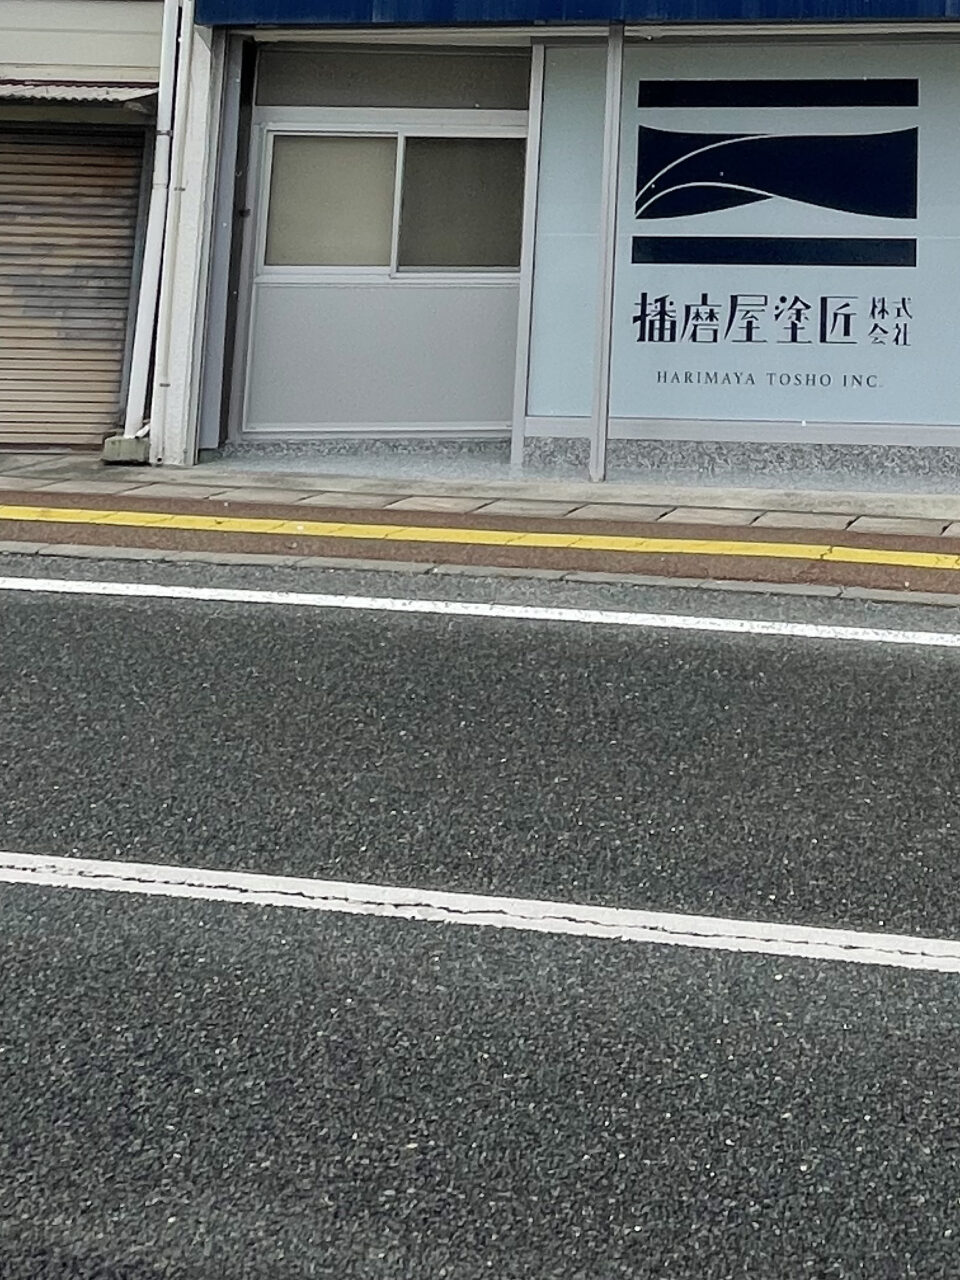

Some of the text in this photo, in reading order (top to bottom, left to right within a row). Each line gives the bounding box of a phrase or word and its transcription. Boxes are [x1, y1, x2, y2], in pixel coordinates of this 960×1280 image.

[633, 292, 858, 344] 播磨屋塗匠
[657, 370, 755, 385] HARIMAYA
[766, 372, 832, 386] TOSHO
